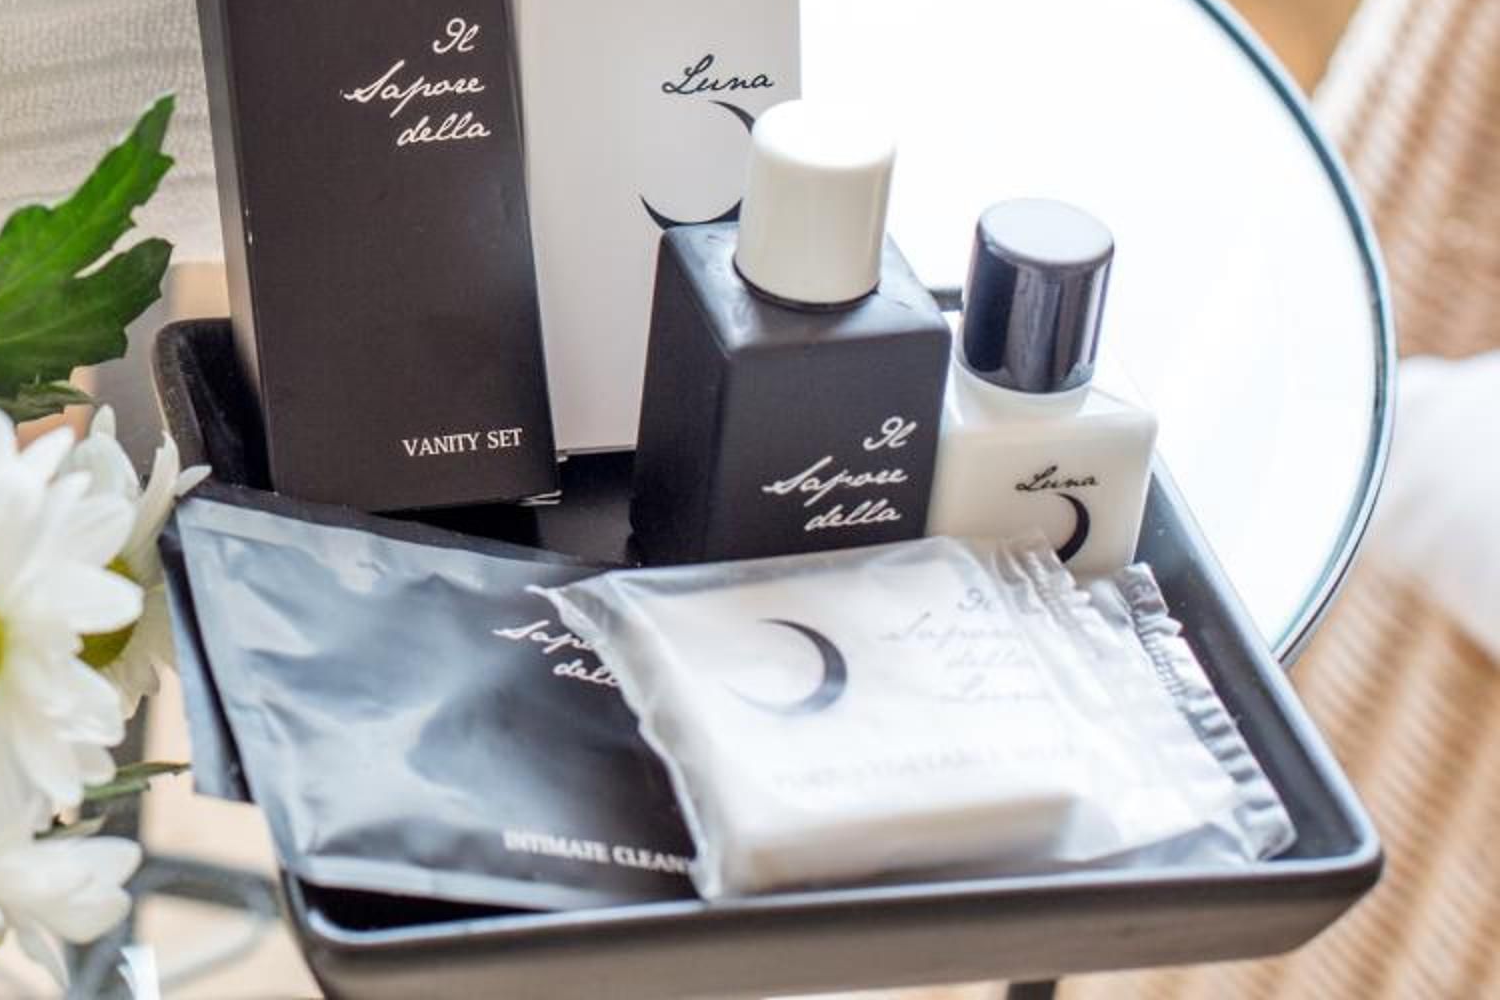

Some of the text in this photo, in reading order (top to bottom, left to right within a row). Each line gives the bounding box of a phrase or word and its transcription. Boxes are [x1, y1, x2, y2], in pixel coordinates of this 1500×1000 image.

[433, 17, 480, 56] Il
[343, 60, 486, 117] Sapore
[661, 53, 776, 96] Luna
[396, 111, 491, 147] della
[401, 427, 523, 458] VANITY SET
[862, 415, 918, 452] Il
[761, 455, 909, 507] Sapore
[1015, 464, 1102, 494] Luna
[803, 499, 902, 533] della
[552, 658, 620, 687] dell
[502, 830, 688, 875] INTIMATE CLEAN
